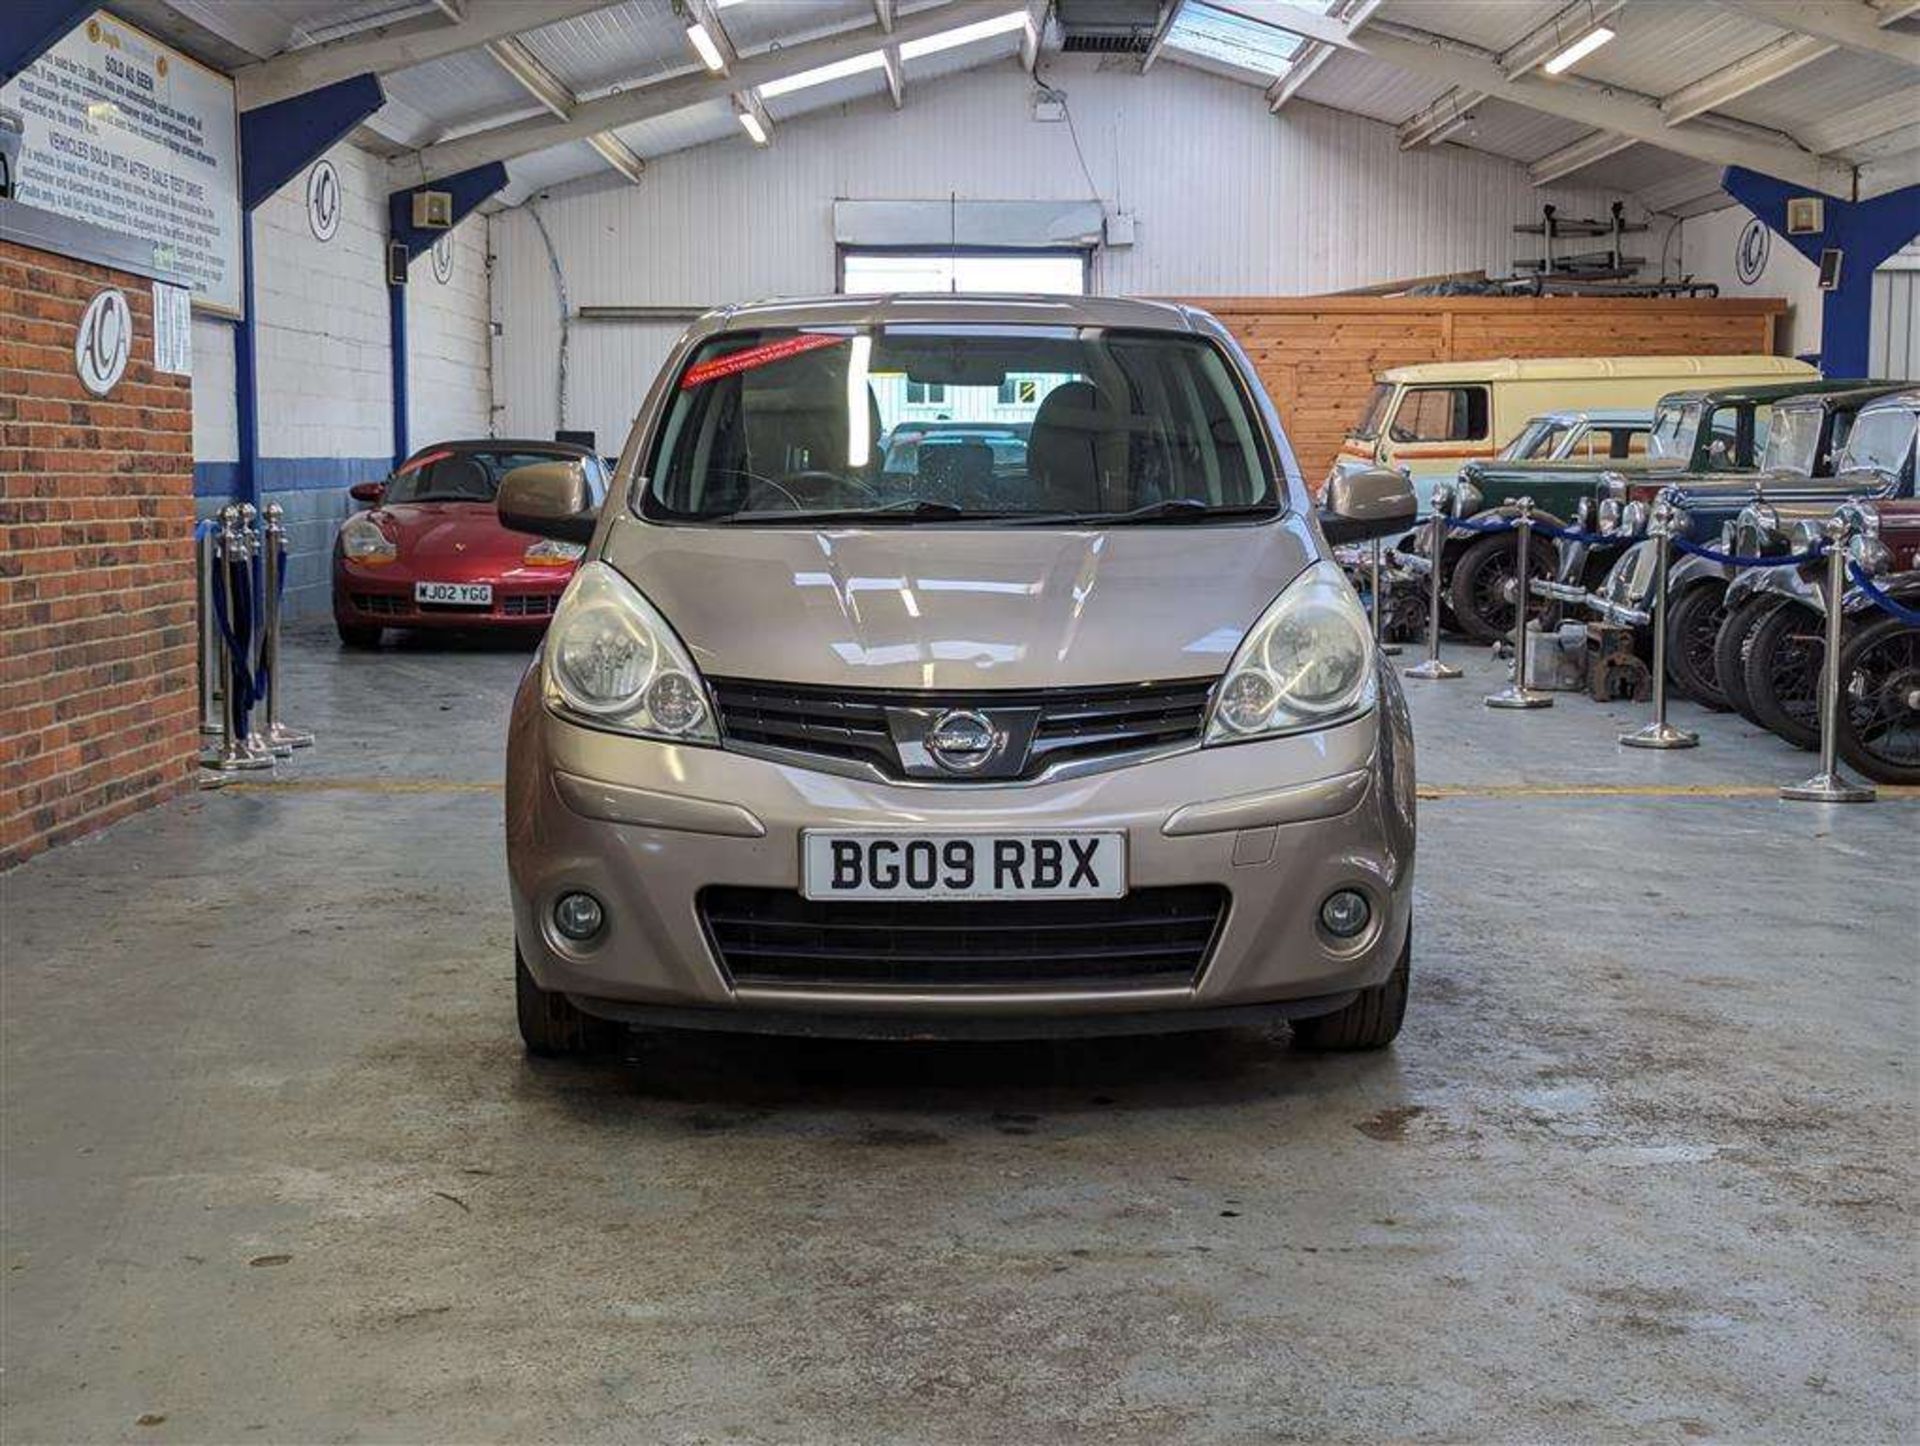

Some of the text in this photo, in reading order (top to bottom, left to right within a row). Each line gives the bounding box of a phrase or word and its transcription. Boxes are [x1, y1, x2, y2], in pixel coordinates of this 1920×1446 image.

[105, 54, 124, 78] SOLD
[125, 63, 133, 82] AS
[136, 69, 152, 91] SEEN
[50, 130, 88, 160] VEHICLES
[90, 145, 109, 168] SOLD
[111, 152, 128, 175] WITH
[130, 159, 148, 182] AFTER
[151, 167, 168, 189] SALE
[169, 174, 184, 195] TEST
[418, 584, 489, 602] WJ02 YGG
[831, 838, 1099, 889] BG09 RBX
